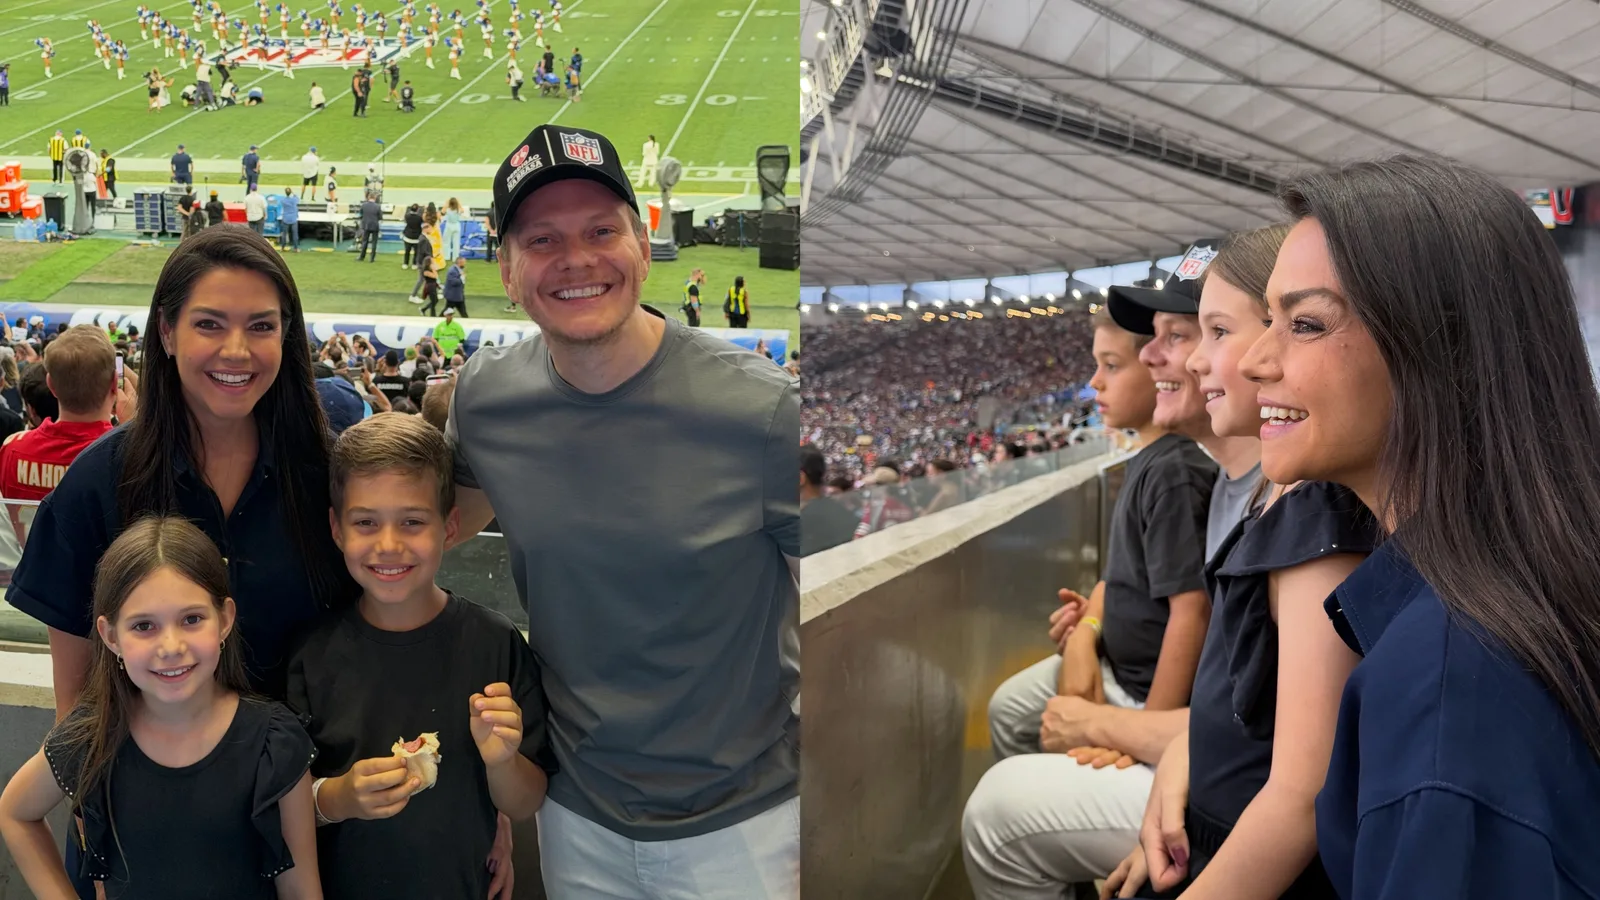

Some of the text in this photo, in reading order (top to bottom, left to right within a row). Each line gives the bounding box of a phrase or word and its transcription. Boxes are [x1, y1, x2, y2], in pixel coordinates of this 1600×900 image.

[568, 144, 598, 160] NFL
[1180, 260, 1202, 275] NFL
[17, 459, 70, 489] MAHO
